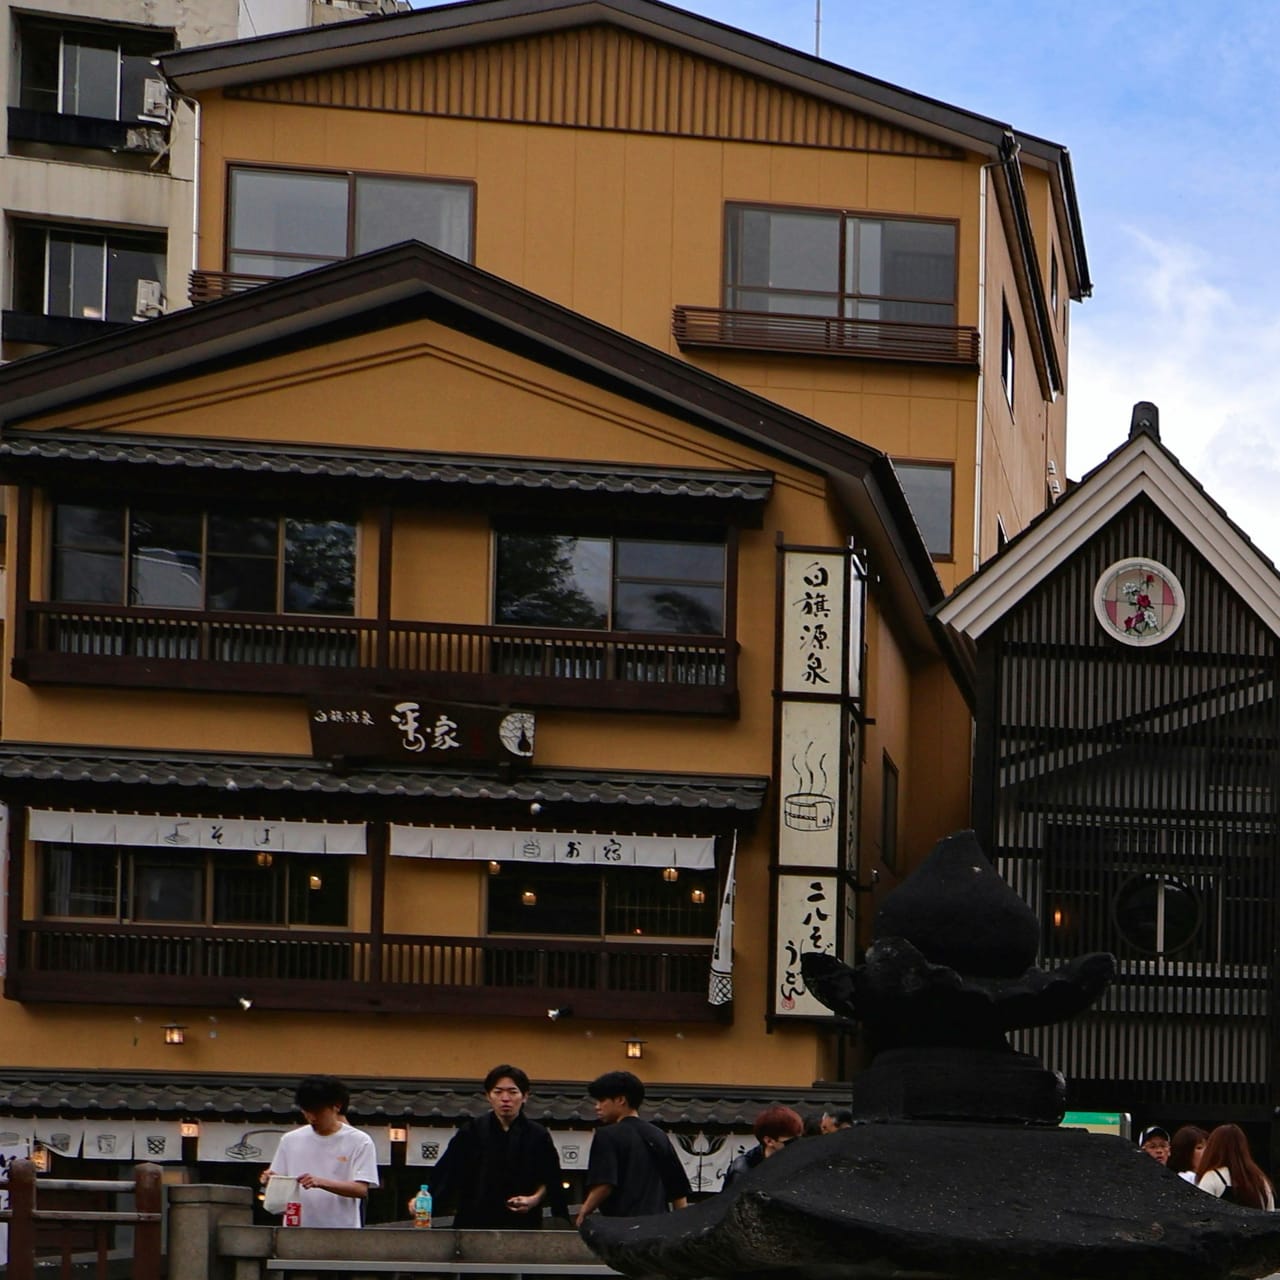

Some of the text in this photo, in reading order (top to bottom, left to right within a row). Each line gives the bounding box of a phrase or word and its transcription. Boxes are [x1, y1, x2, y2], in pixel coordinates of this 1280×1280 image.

[792, 561, 831, 685] 白旗源泉
[800, 882, 834, 955] 二八そ
